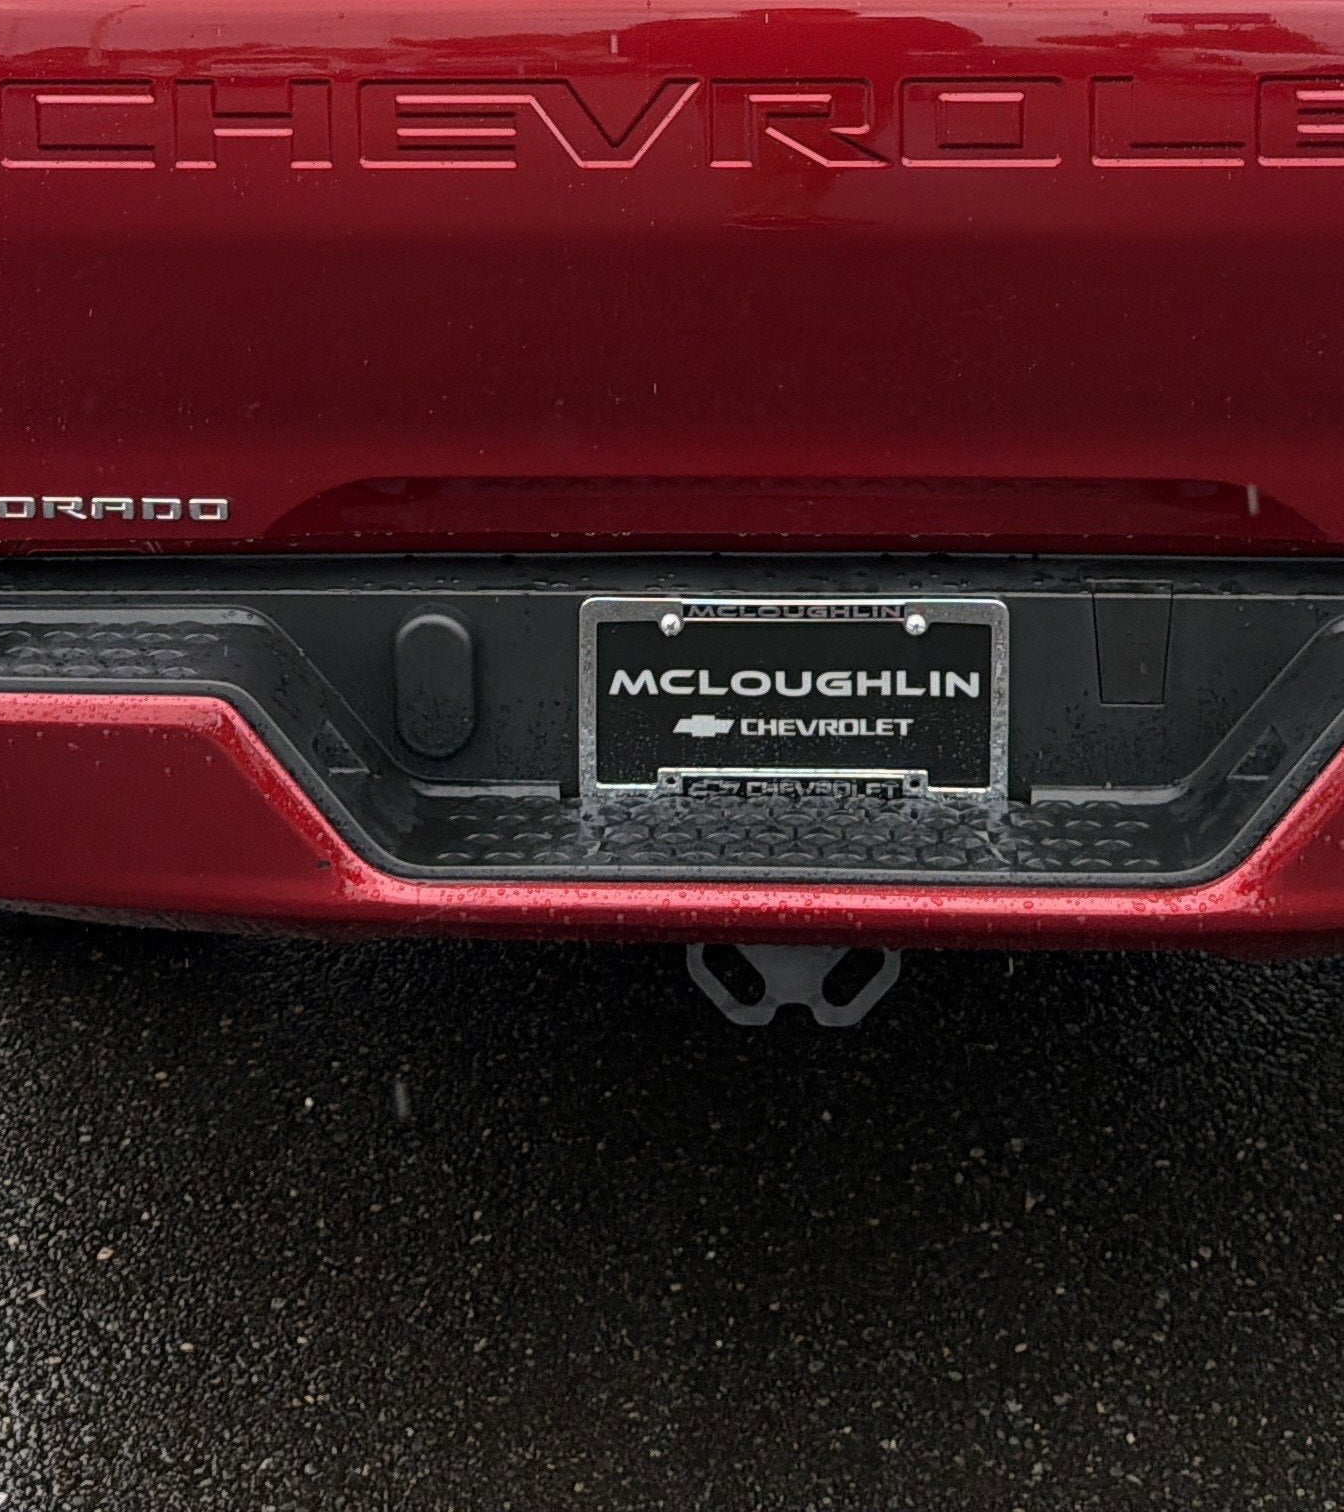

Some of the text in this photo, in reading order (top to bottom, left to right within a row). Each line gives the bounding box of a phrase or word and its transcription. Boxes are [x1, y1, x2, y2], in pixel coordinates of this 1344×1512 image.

[687, 605, 901, 619] MCLOUGHLIN
[608, 668, 981, 699] MCLOUGHLIN
[739, 717, 915, 738] CHEVROLET
